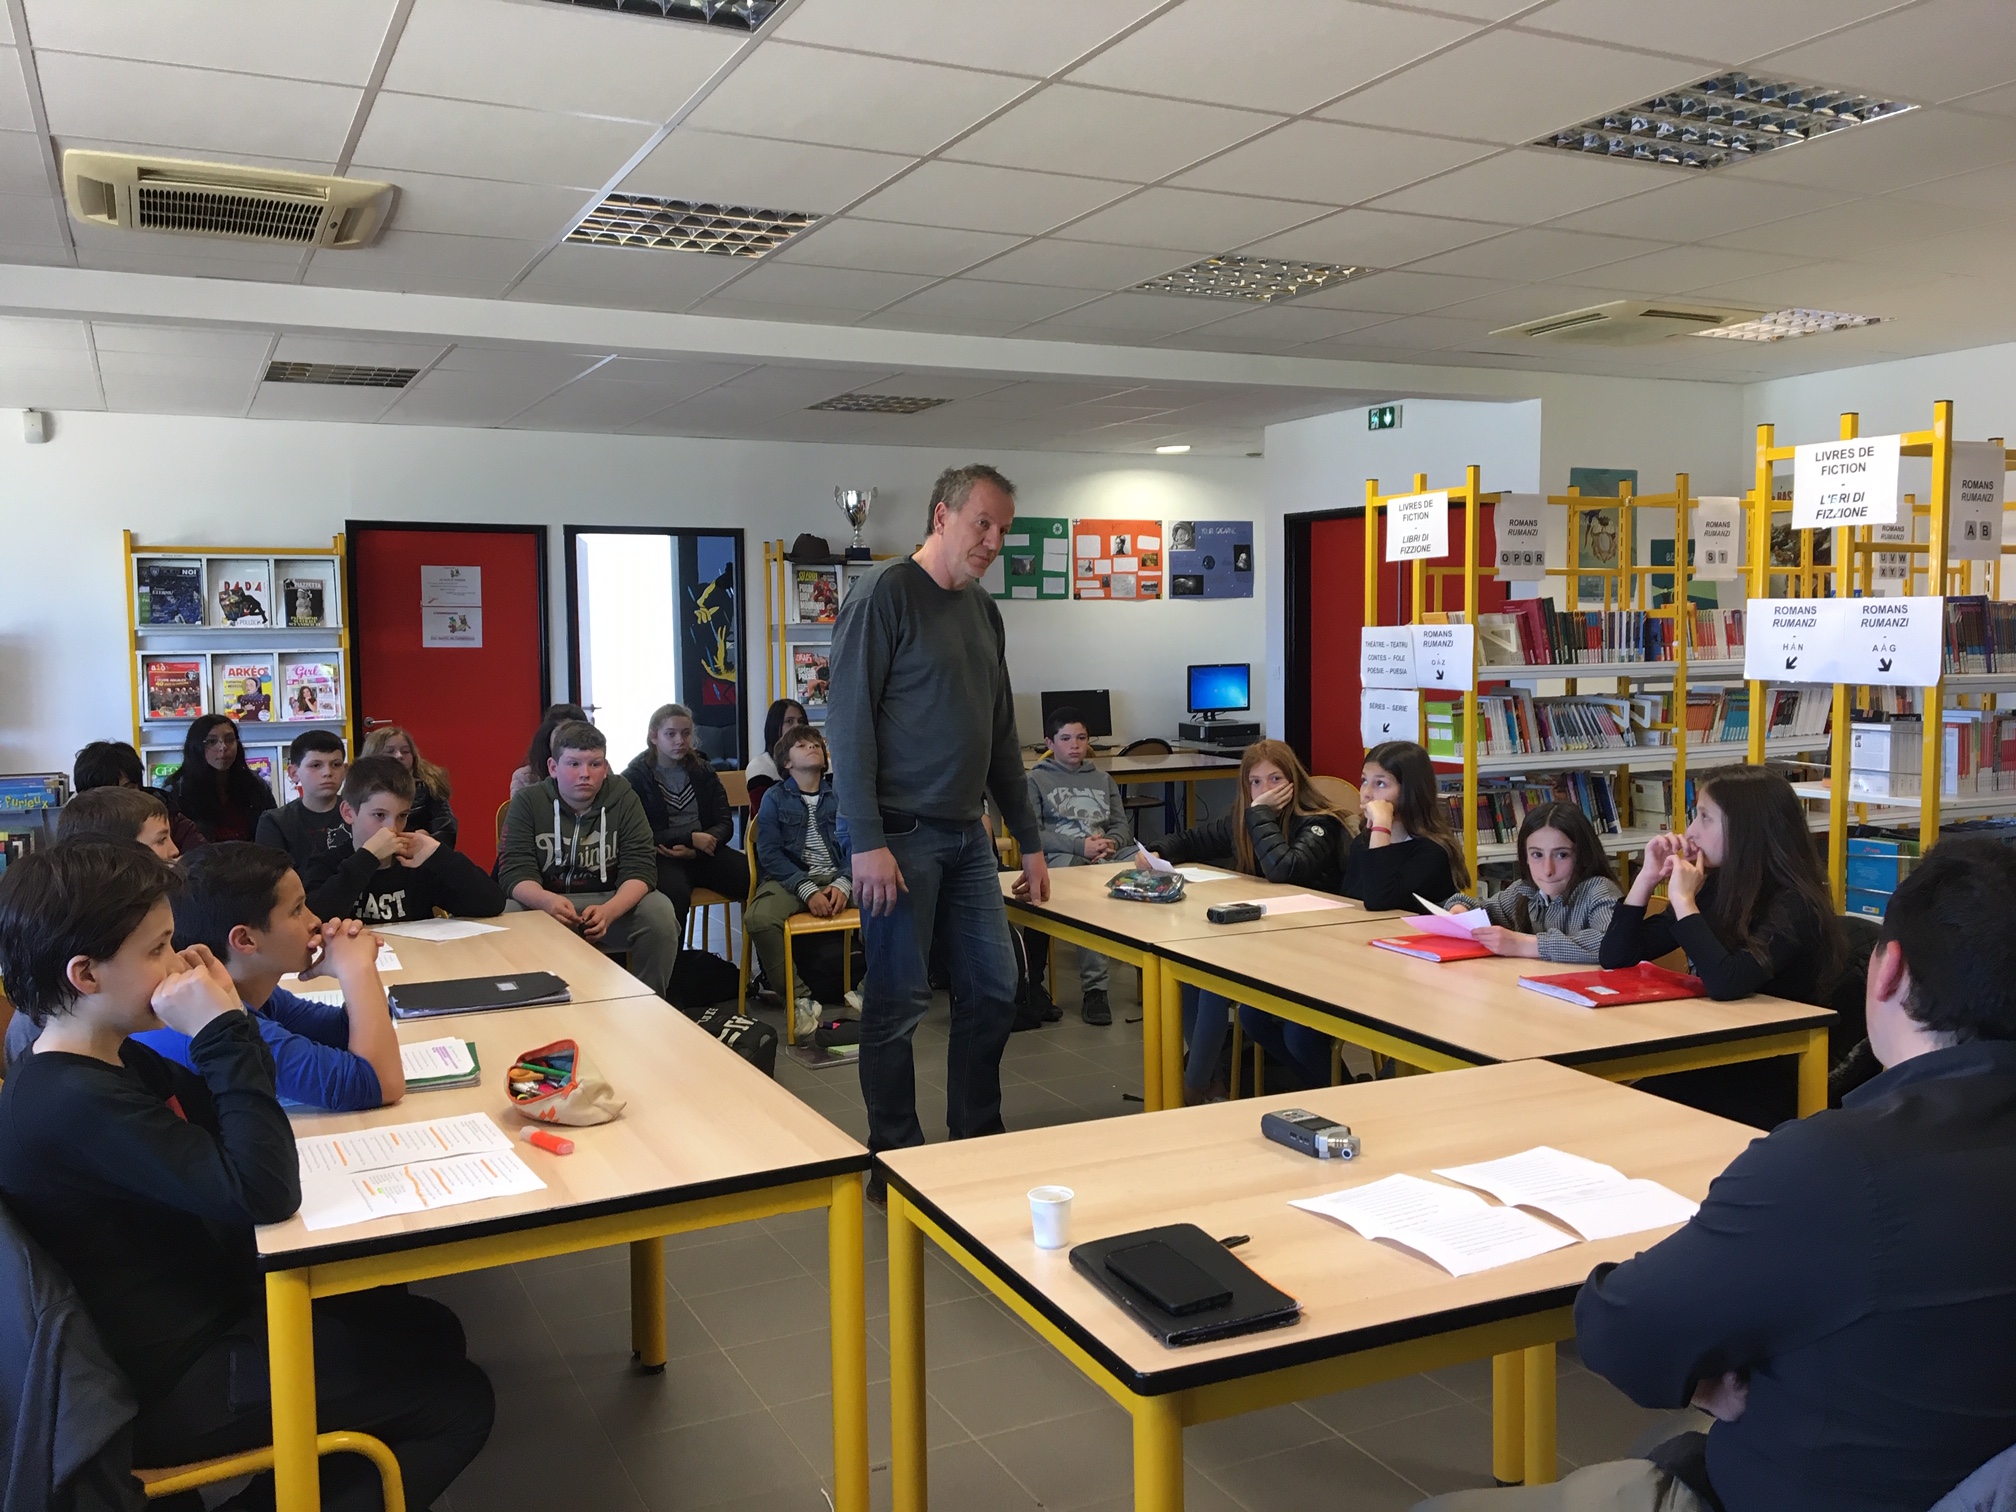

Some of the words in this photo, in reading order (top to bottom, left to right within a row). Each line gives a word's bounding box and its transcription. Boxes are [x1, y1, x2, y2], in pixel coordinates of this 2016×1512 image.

[1815, 448, 1855, 462] LIVRES
[1858, 446, 1875, 457] DE
[1821, 462, 1867, 476] FICTION
[1962, 480, 1994, 490] ROMANS
[1853, 492, 1865, 502] DI
[1961, 492, 1994, 502] RUMANZI
[1399, 501, 1422, 512] LIVRES
[1424, 499, 1434, 508] DE
[1402, 511, 1429, 522] FICTION
[1509, 519, 1538, 527] ROMANS
[1507, 528, 1539, 536] RUMANZI
[1967, 525, 1975, 536] A
[1982, 525, 1989, 536] B
[1402, 534, 1421, 544] LIBRI
[1422, 533, 1429, 542] DI
[1400, 544, 1432, 555] FIZZIONE
[1502, 553, 1509, 563] O
[1514, 553, 1520, 562] P
[1524, 553, 1531, 563] Q
[1536, 553, 1543, 562] R
[1708, 553, 1714, 561] S
[1720, 553, 1726, 561] T
[1898, 554, 1907, 562] W
[1881, 568, 1886, 576] X
[1890, 568, 1895, 576] Y
[224, 581, 262, 592] DADA
[1774, 606, 1817, 615] ROMANS
[1862, 605, 1908, 614] ROMANS
[1772, 618, 1817, 628] RUMANZI
[1860, 618, 1909, 628] RUMANZI
[1423, 630, 1453, 638] ROMANS
[1423, 640, 1454, 648] RUMANZI
[1782, 643, 1789, 651] H
[1798, 643, 1804, 651] N
[1889, 644, 1897, 652] G
[228, 665, 265, 677] ARKÉO
